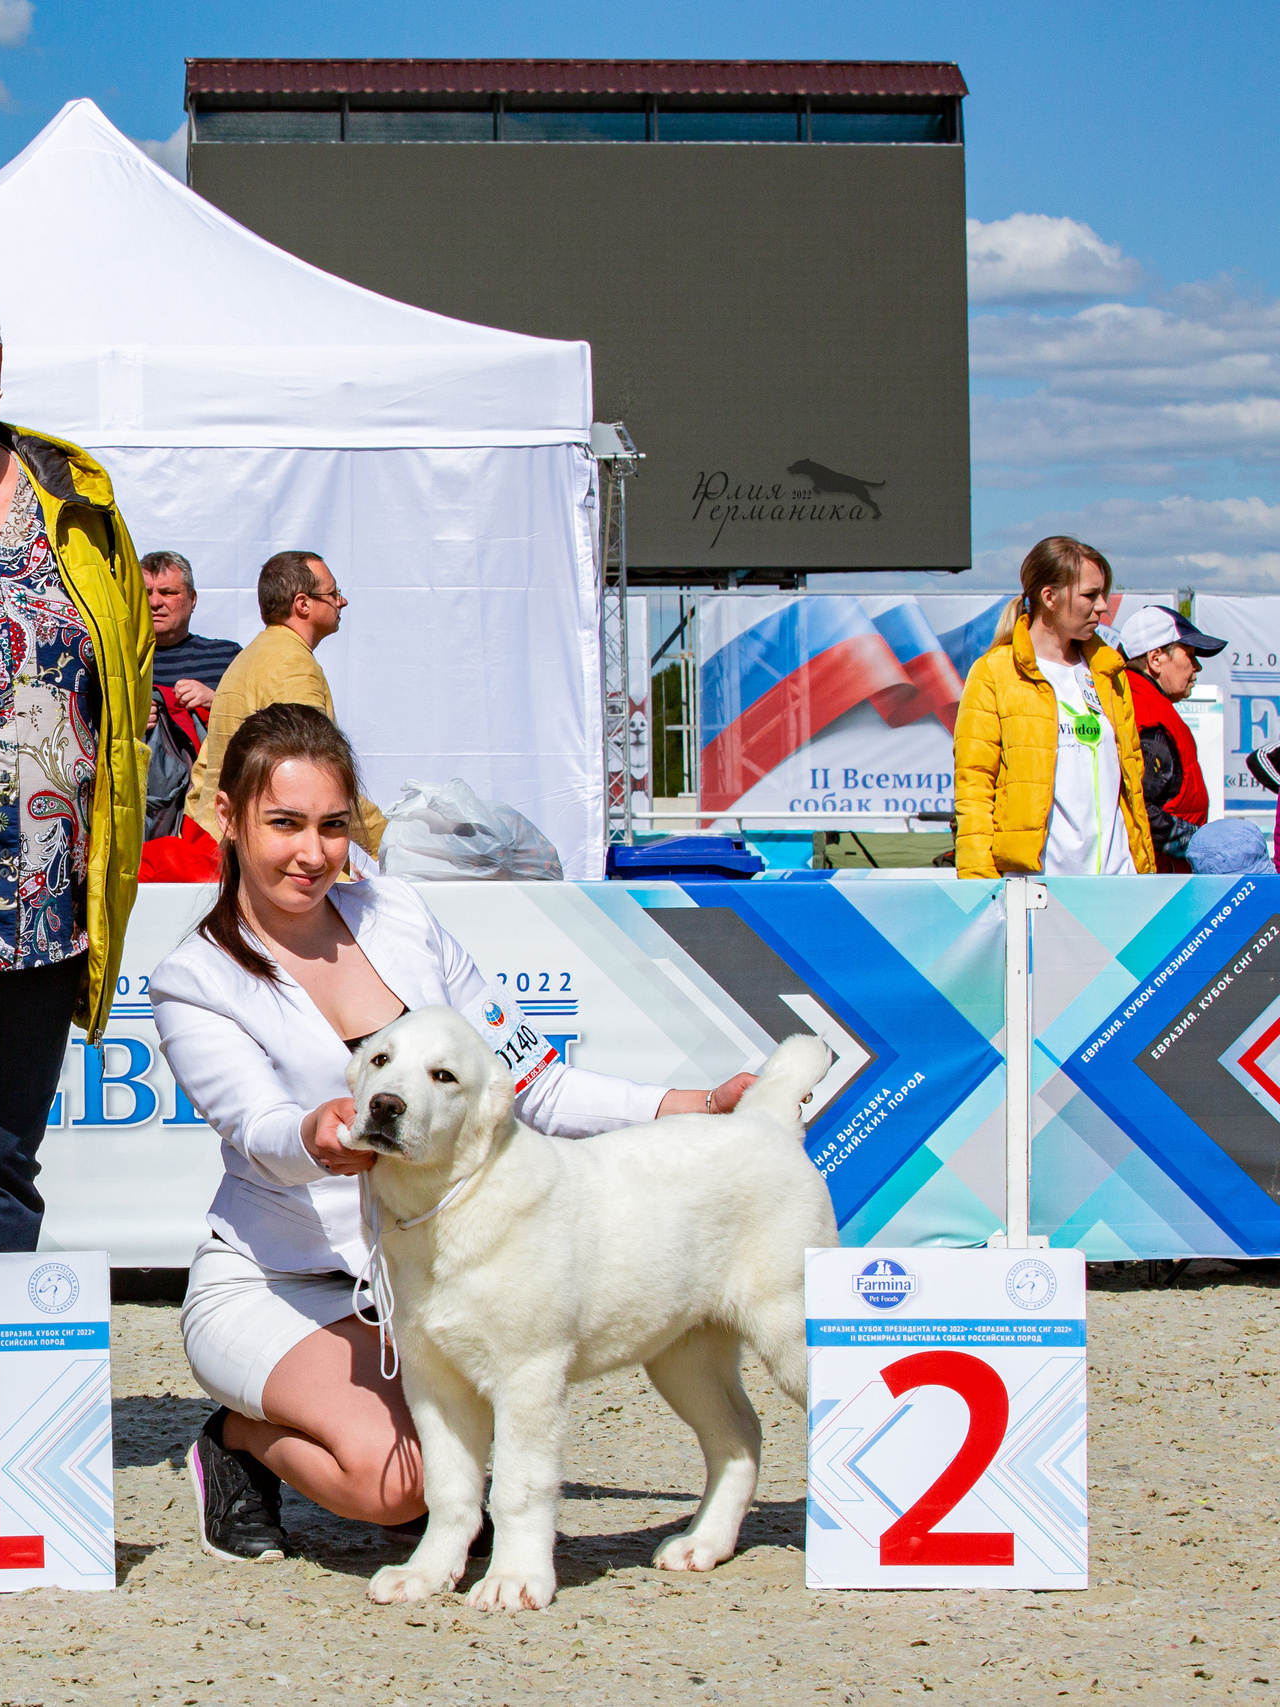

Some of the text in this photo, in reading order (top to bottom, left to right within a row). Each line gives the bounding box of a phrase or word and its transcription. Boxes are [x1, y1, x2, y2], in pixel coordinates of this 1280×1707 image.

[810, 768, 952, 794] II Всемир
[1080, 881, 1256, 1063] ЕВРАЗИЯ. КУБОК ПРЕЗИДЕНТА РКФ 2022
[1150, 925, 1280, 1060] ЕВРАЗИЯ. КУБОК СНГ 2022
[820, 1071, 926, 1179] РОССИЙСКИХ ПОРОД
[836, 1088, 891, 1143] ВЫСТАВКА
[856, 1277, 911, 1291] Farmina
[40, 1338, 65, 1346] ПОРОД
[819, 1325, 857, 1333] «ЕВРАЗИЯ.
[858, 1325, 882, 1333] КУБОК
[884, 1325, 931, 1334] ПРЕЗИДЕНТА
[932, 1325, 948, 1333] РКФ
[974, 1325, 1011, 1333] «ЕВРАЗИЯ.
[1013, 1325, 1037, 1333] КУБОК
[1038, 1325, 1052, 1333] СНГ
[968, 1333, 1014, 1342] РОССИЙСКИХ
[1016, 1335, 1042, 1343] ПОРОД
[879, 1350, 1014, 1566] 2
